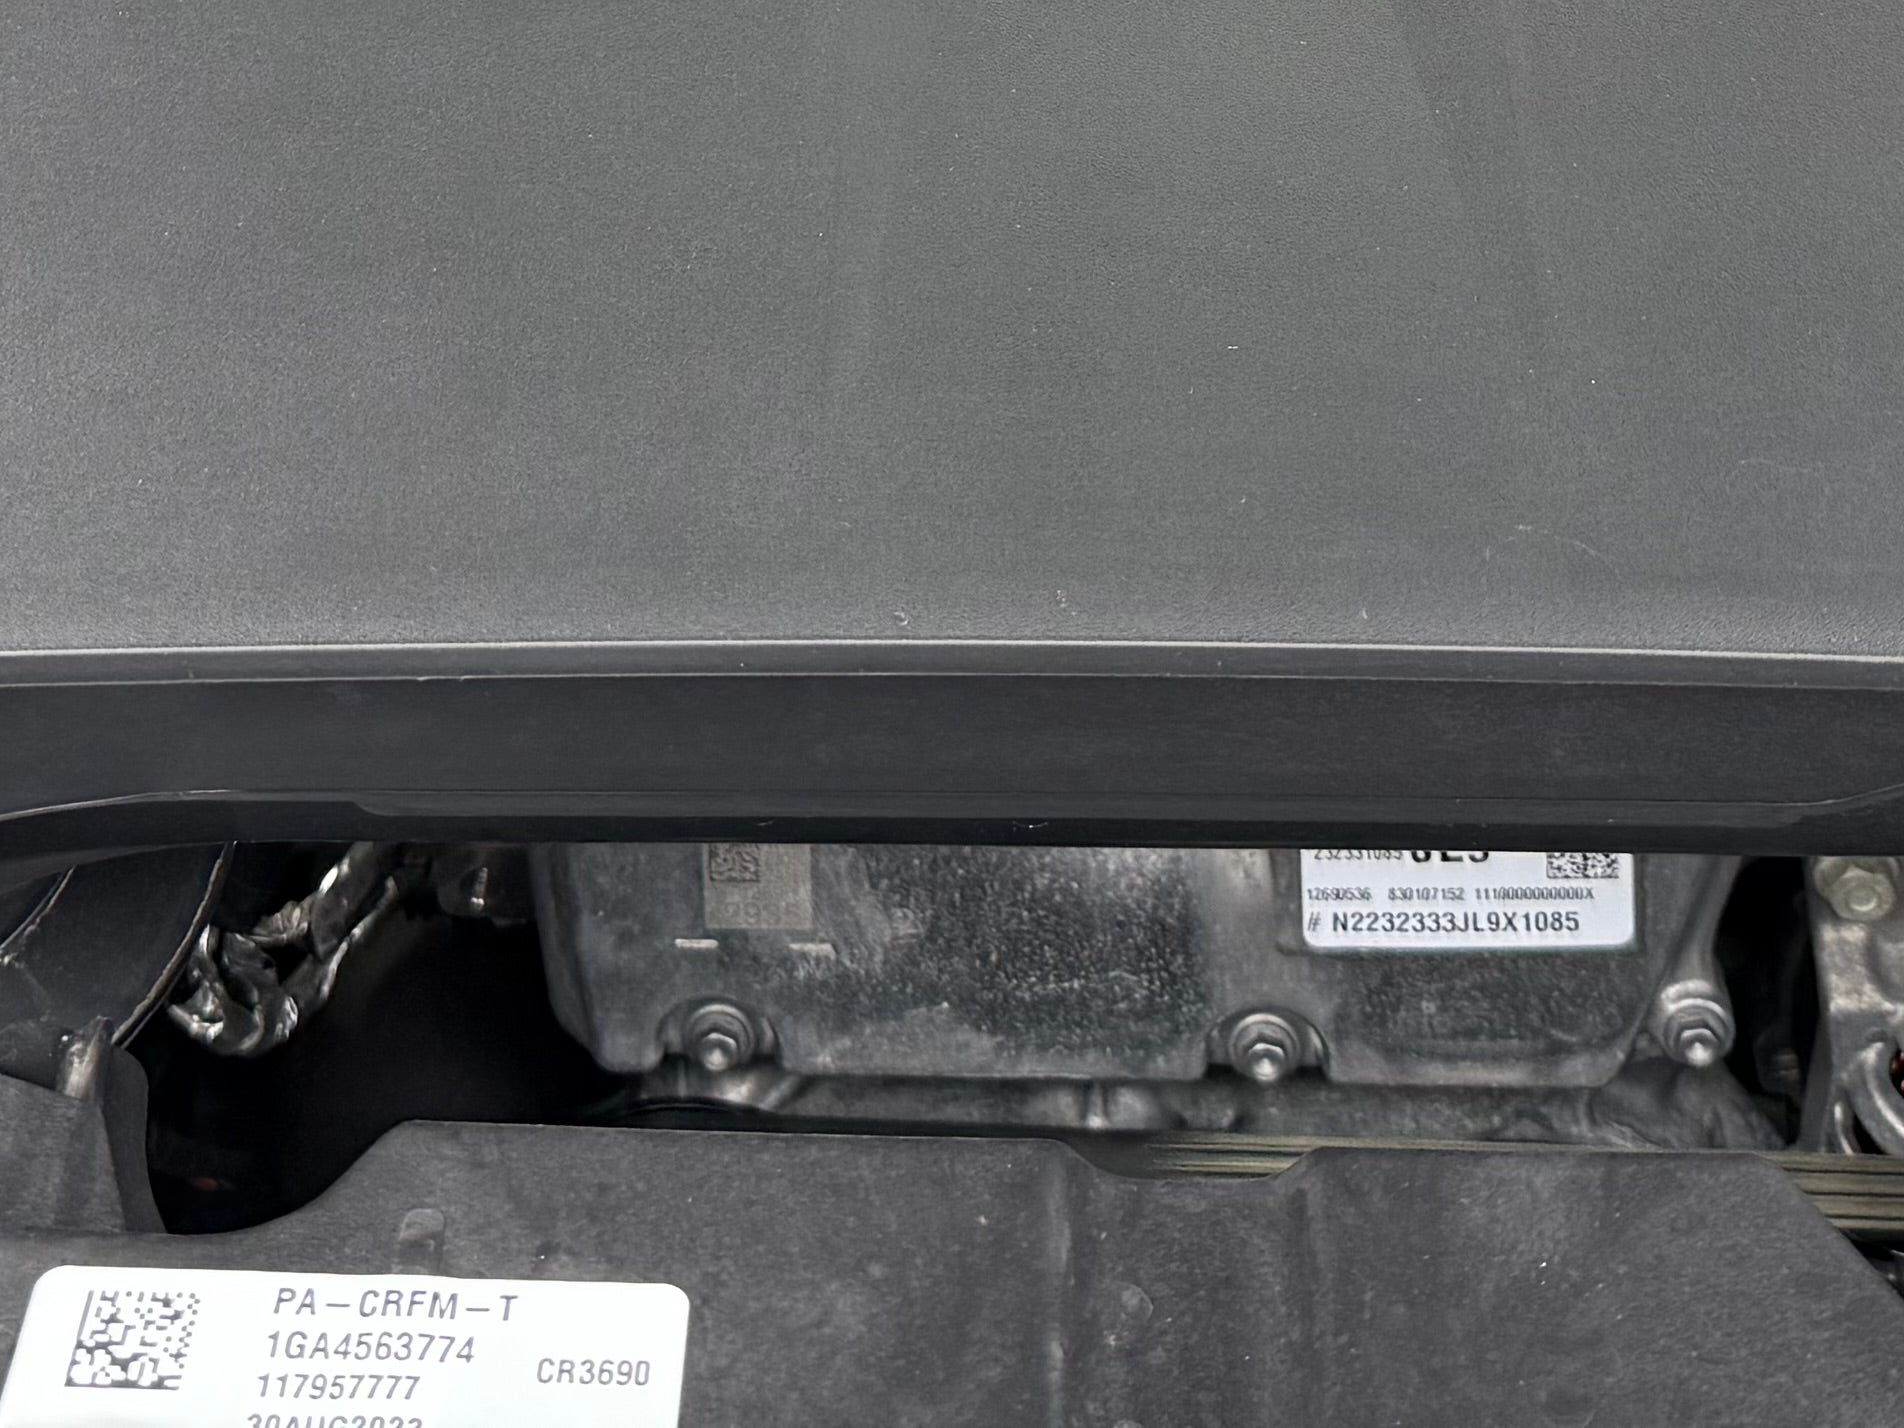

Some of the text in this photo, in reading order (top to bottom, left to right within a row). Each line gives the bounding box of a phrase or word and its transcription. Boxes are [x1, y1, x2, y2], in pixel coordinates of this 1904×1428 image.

[1307, 911, 1580, 933] # N2232333JL9X1085
[266, 1331, 477, 1364] 1GA4563774
[256, 1372, 422, 1402] 117957777
[535, 1357, 652, 1388] CR3690
